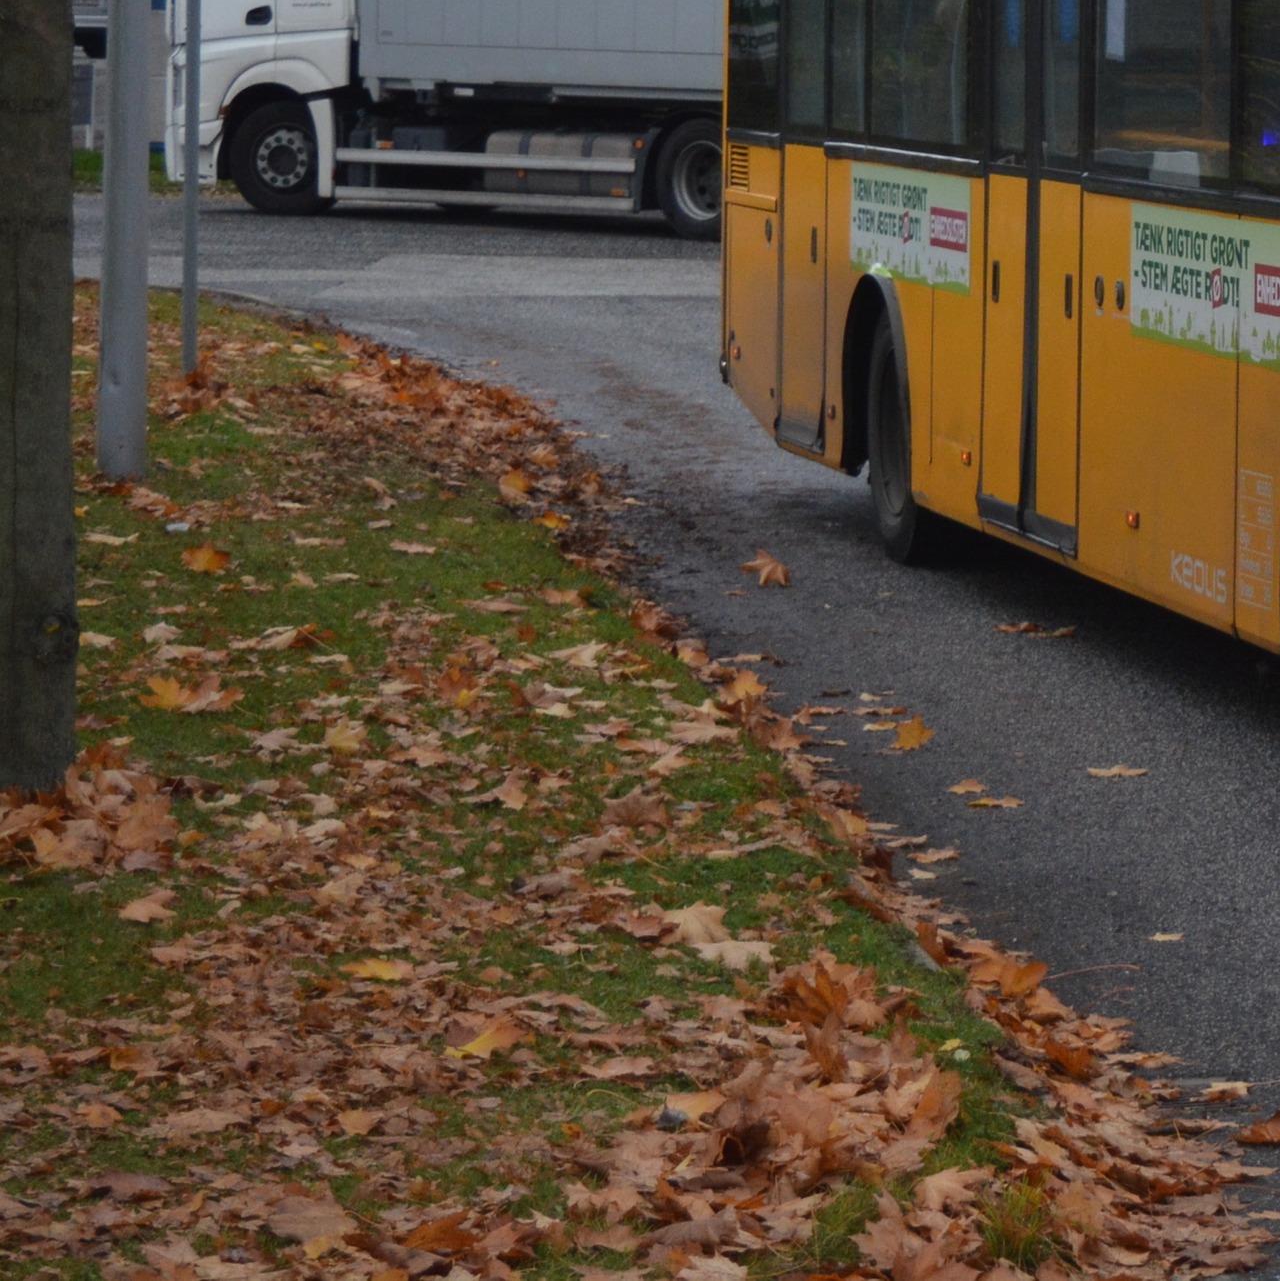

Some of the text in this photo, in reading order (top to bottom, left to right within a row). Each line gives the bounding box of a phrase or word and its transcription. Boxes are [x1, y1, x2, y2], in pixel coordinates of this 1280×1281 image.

[1135, 221, 1250, 270] TÆNK RIGTIGT GRØNT
[1141, 259, 1169, 292] STEM
[1170, 265, 1202, 300] ÆGTE
[1204, 272, 1241, 308] RØDT!
